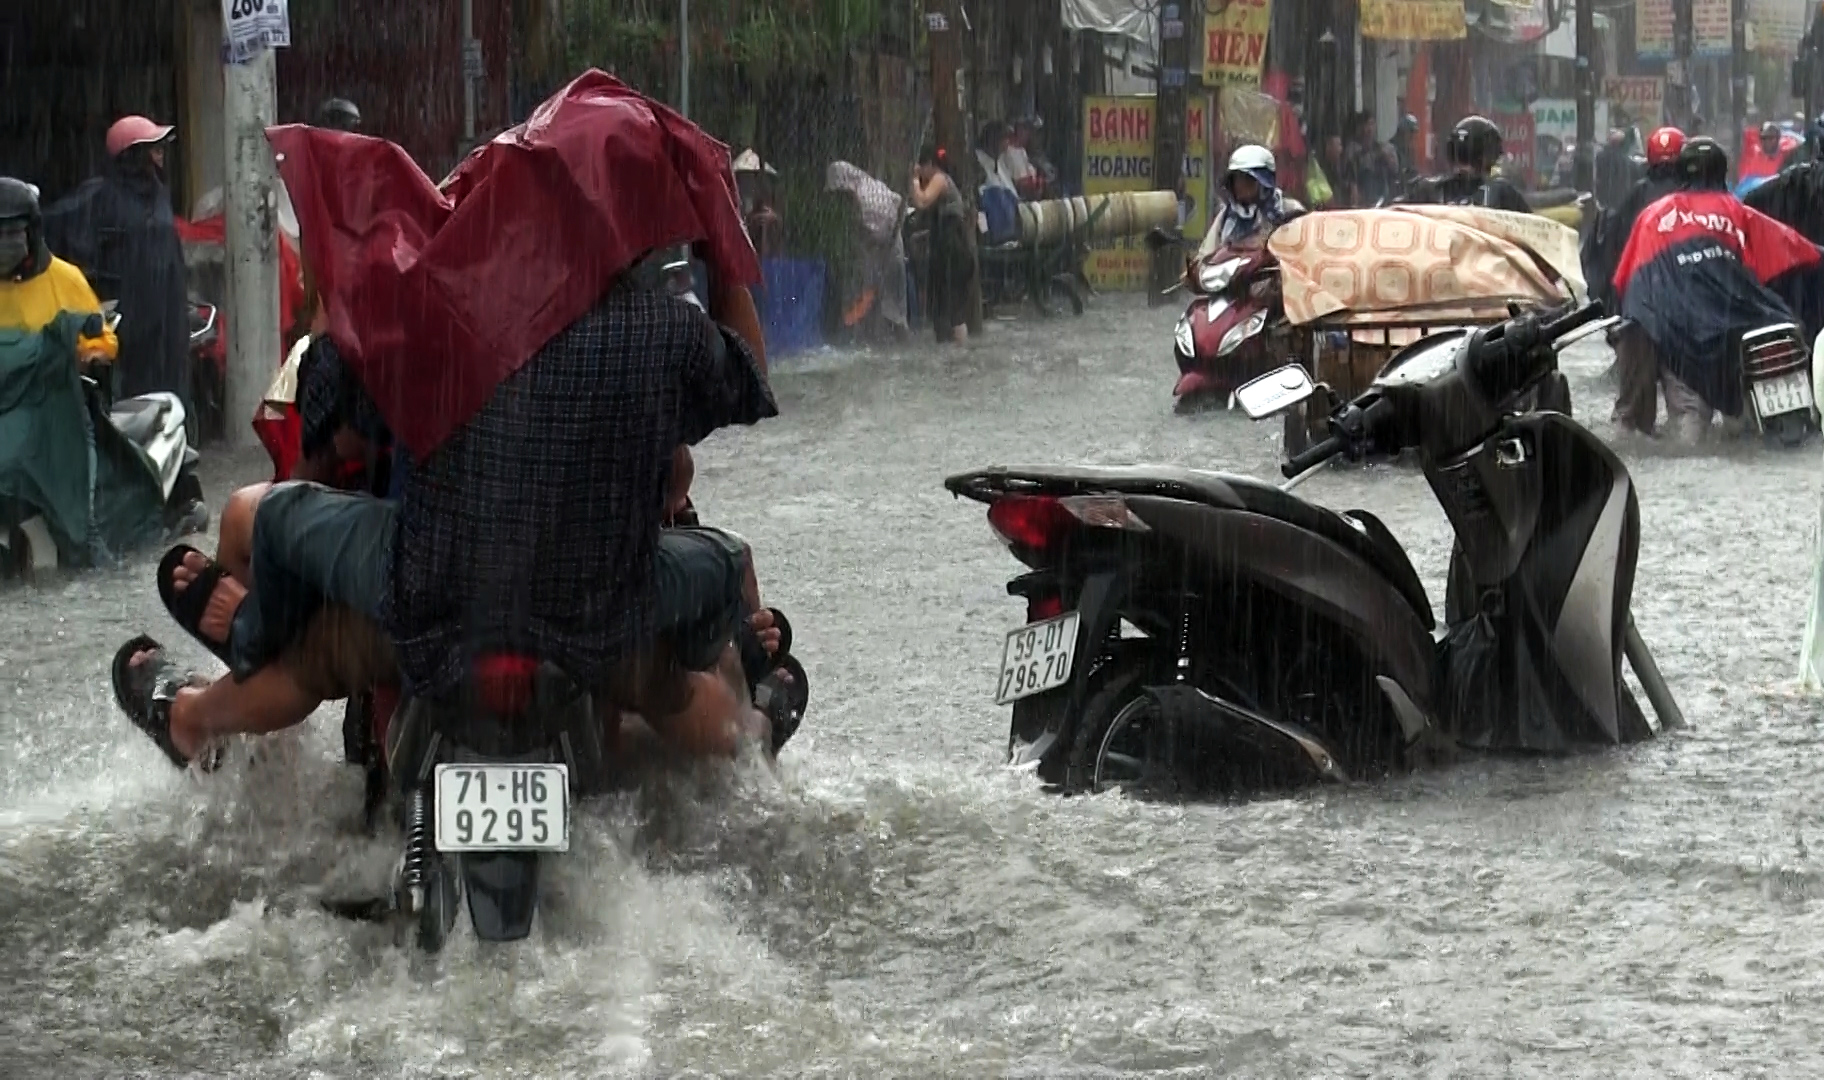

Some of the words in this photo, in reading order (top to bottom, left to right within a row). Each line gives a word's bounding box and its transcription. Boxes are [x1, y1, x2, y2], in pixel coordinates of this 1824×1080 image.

[1014, 621, 1064, 661] 59-D1
[1002, 651, 1067, 699] 796.70
[455, 771, 548, 804] 71-H6
[456, 808, 549, 844] 9295
